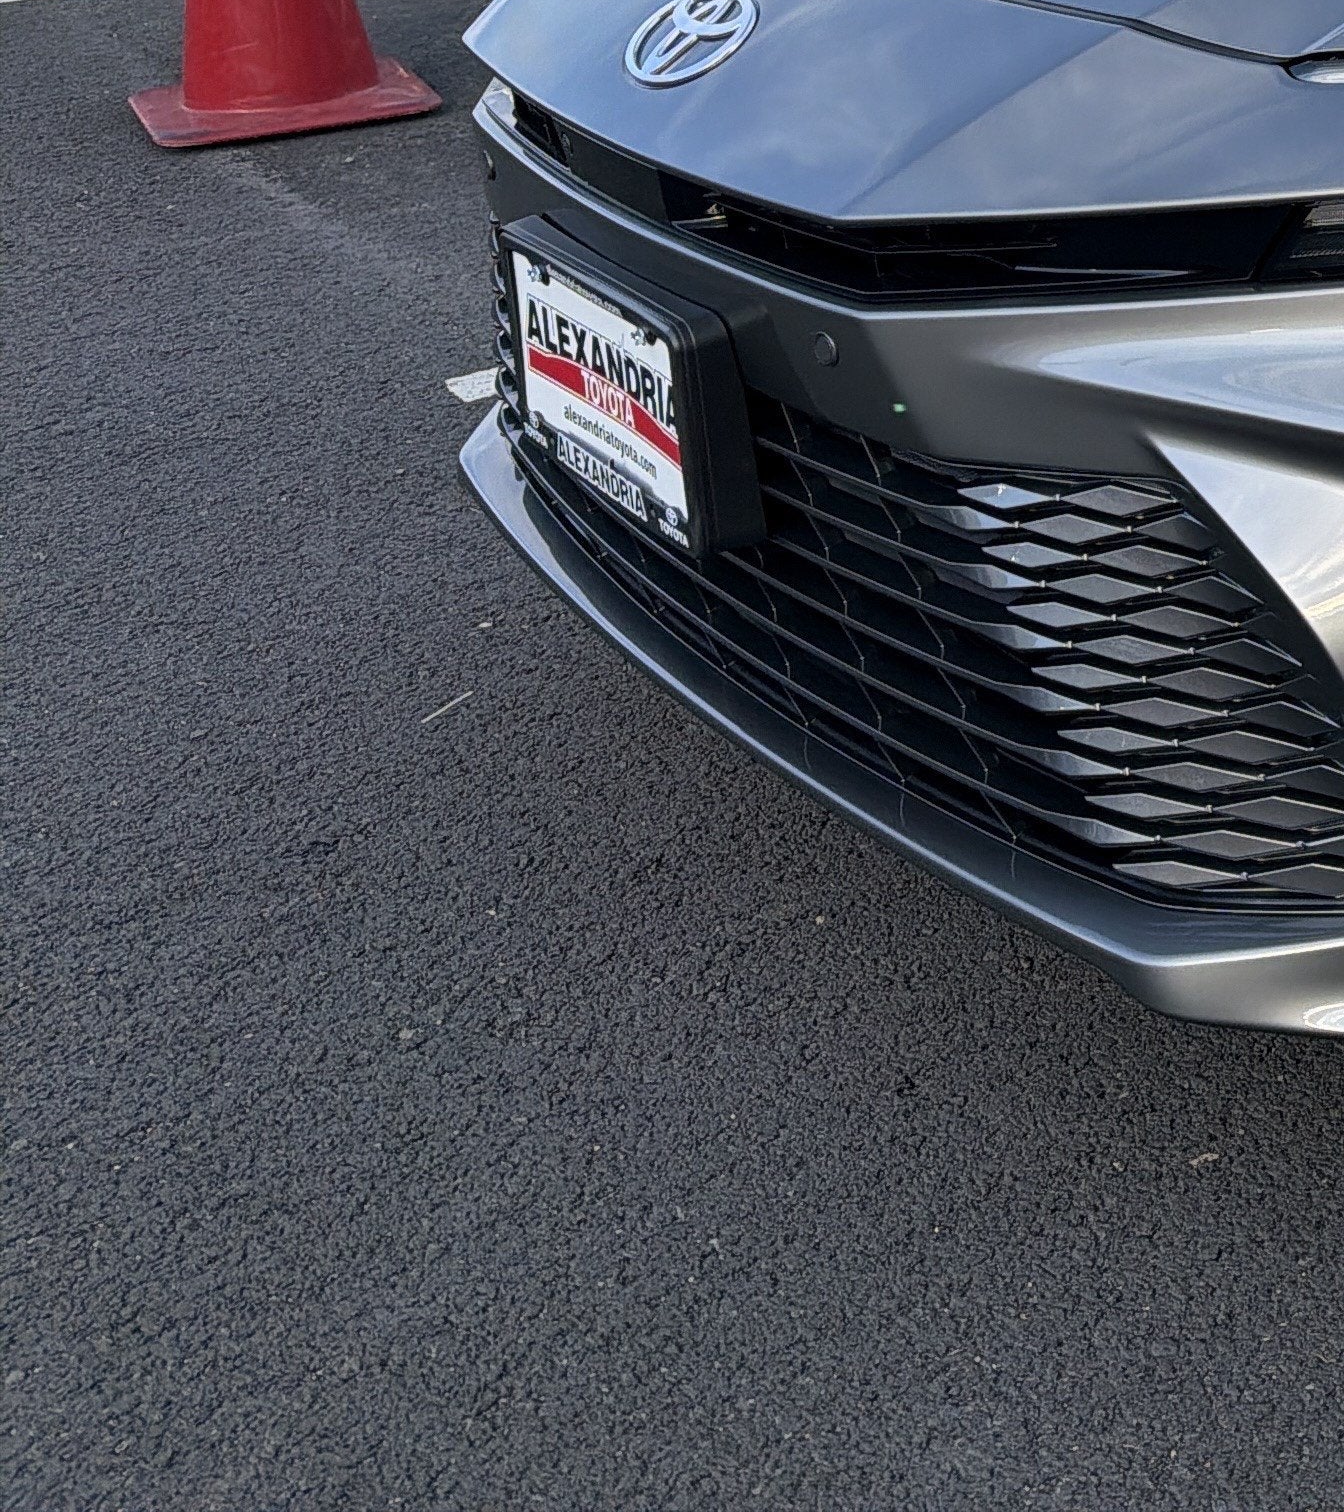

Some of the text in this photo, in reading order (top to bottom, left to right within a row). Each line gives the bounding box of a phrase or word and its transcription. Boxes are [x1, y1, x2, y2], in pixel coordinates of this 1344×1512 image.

[527, 298, 676, 428] ALEXANDRIA
[580, 369, 636, 429] TOYOTA
[557, 433, 648, 522] ALEXANDRIA
[563, 404, 657, 479] alexandriatoyota.com
[658, 517, 690, 549] TOYOTA
